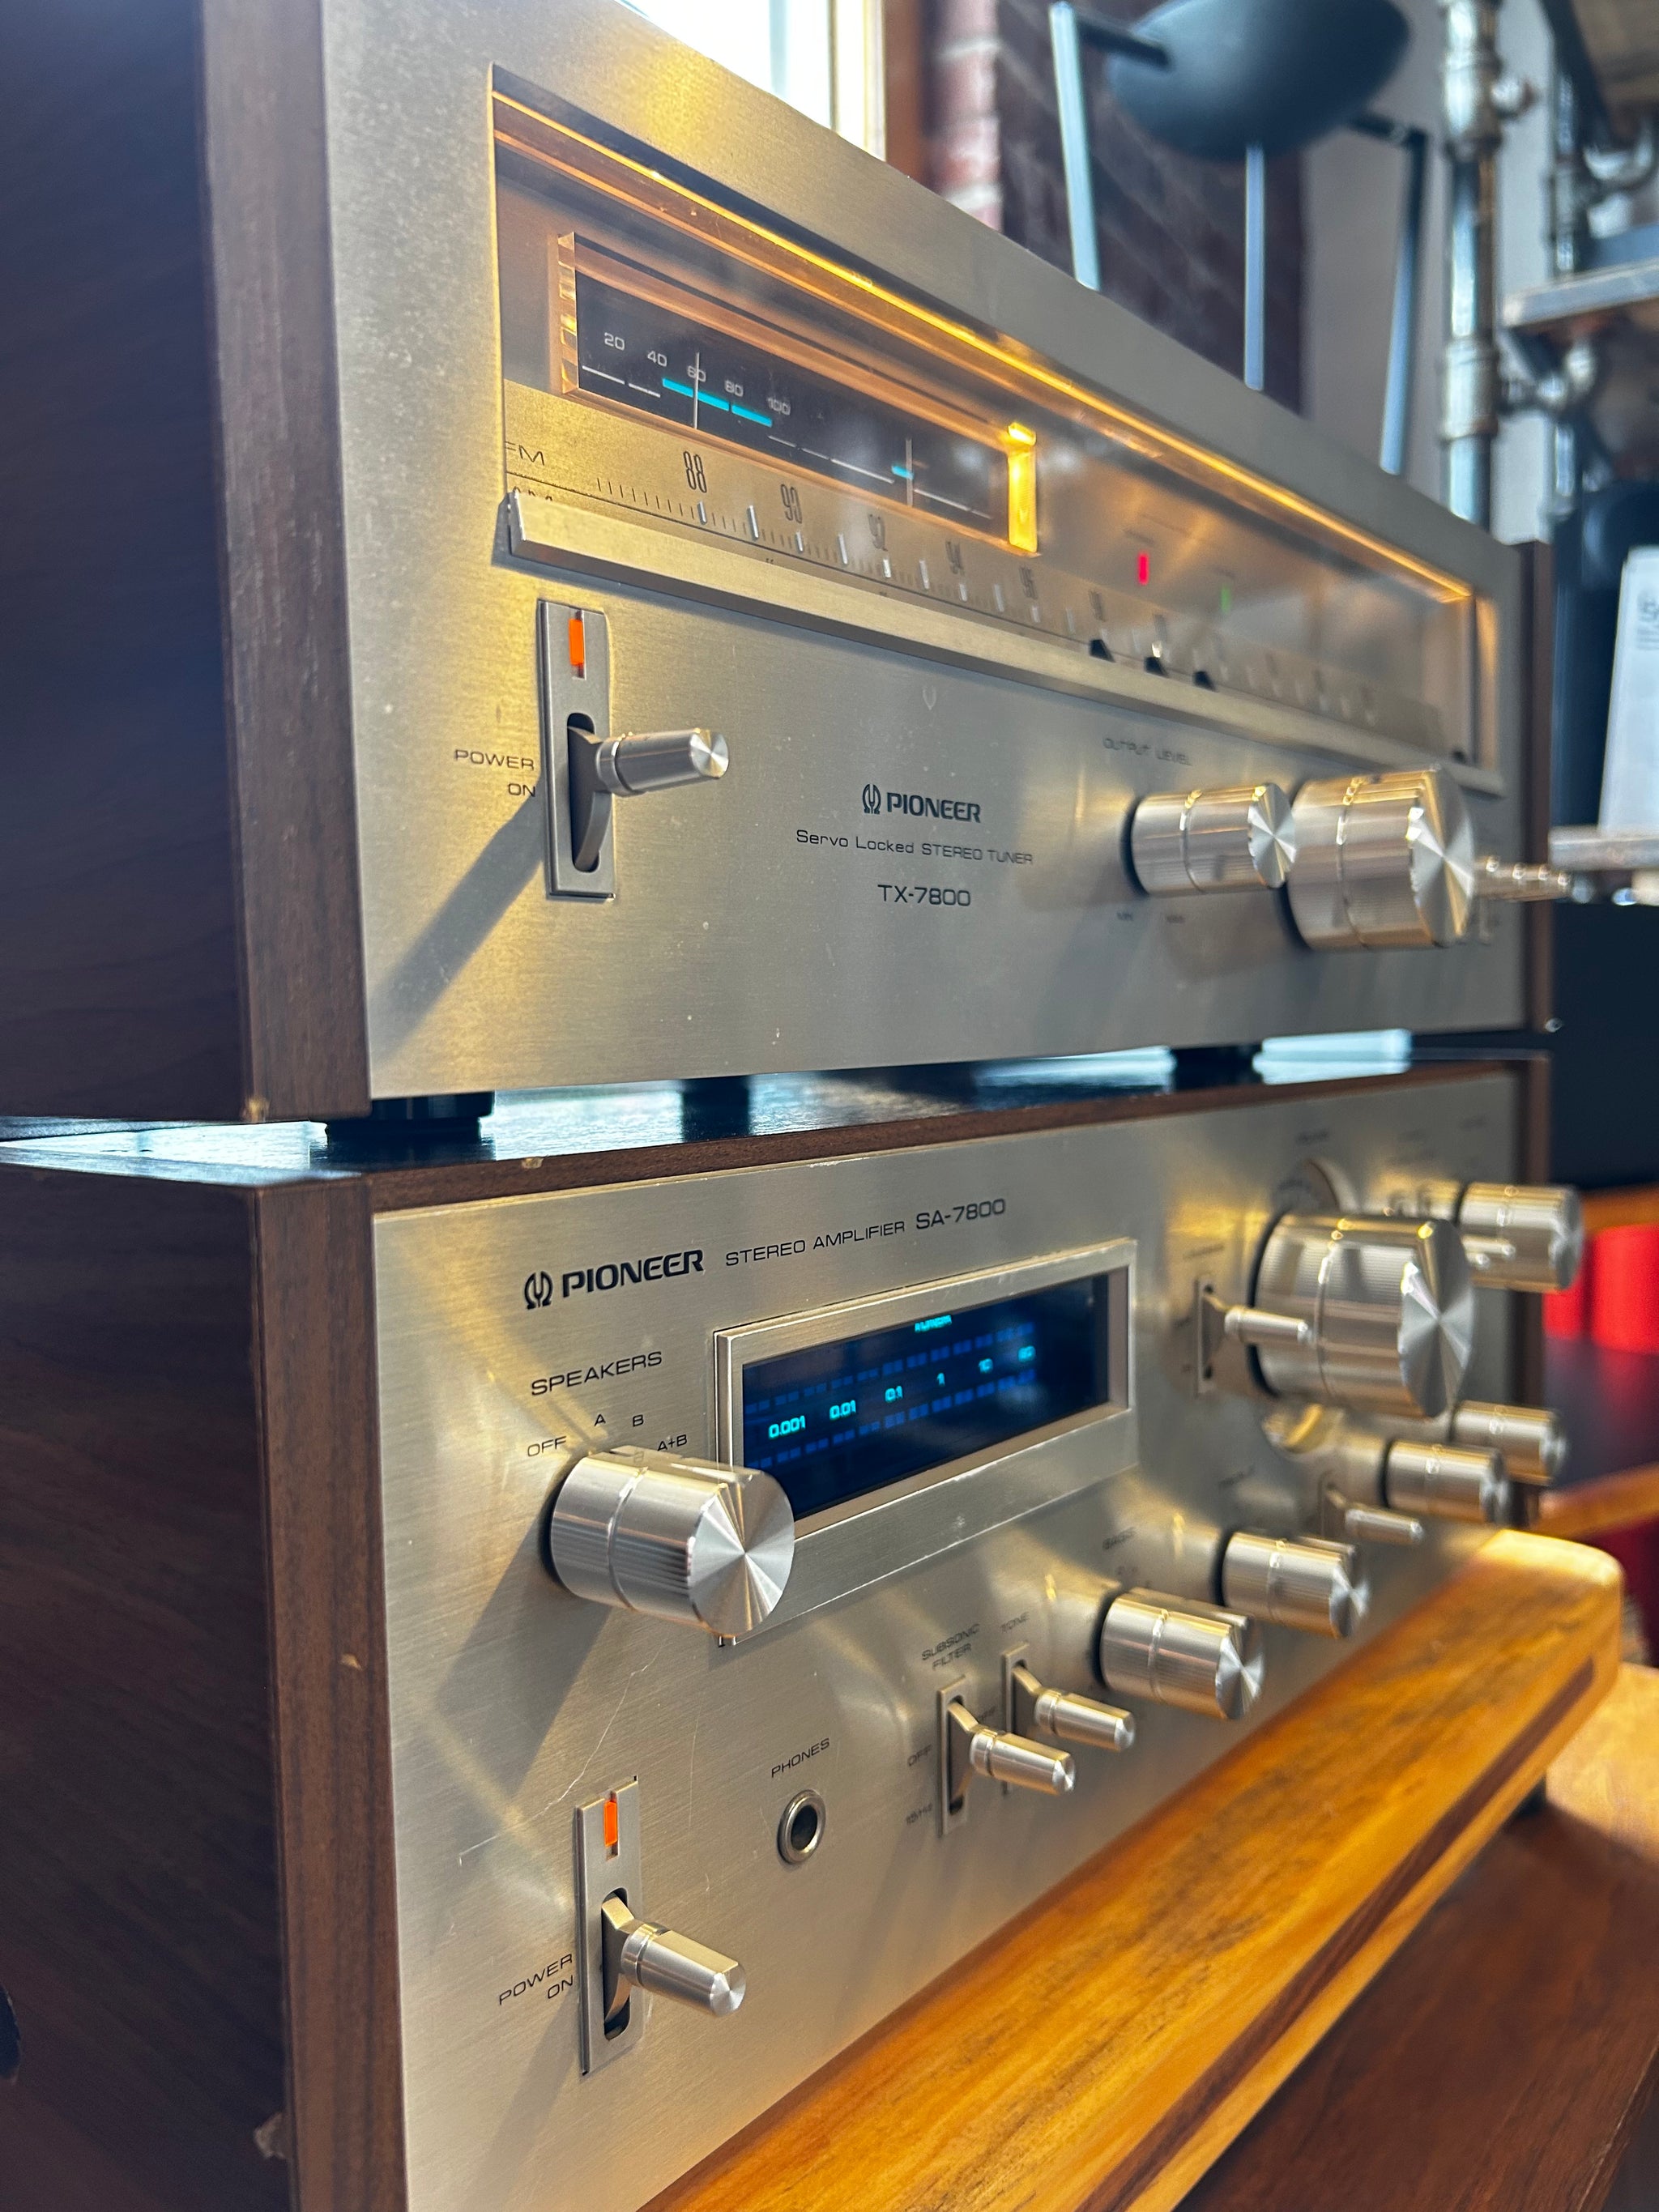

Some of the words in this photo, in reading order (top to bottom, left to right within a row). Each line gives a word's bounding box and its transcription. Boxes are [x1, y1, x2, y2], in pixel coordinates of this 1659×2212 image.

[603, 332, 625, 351] 20
[647, 350, 667, 368] 40
[687, 364, 707, 383] 60
[725, 379, 744, 398] 80
[767, 397, 791, 416] 100
[683, 450, 707, 493] 88
[780, 484, 803, 524] 90
[454, 748, 535, 771] POWER
[507, 782, 536, 797] ON
[886, 792, 981, 823] PIONEER
[795, 829, 849, 848] Servo
[855, 836, 915, 855] Locked
[921, 843, 983, 861] STEREO
[987, 849, 1034, 866] TUNER
[877, 884, 972, 906] TX-7800
[725, 1239, 806, 1267] STEREO
[812, 1221, 906, 1250] AMPLIFIER
[915, 1198, 1006, 1230] SA-7800
[561, 1248, 704, 1298] PIONEER
[531, 1350, 663, 1396] SPEAKERS
[594, 1413, 606, 1427] A
[632, 1414, 645, 1427] B
[769, 1415, 806, 1438] 0.001
[830, 1400, 856, 1420] 0.01
[527, 1435, 567, 1457] OFF
[657, 1434, 689, 1452] A+B
[921, 1622, 980, 1660] SUBSONIC
[932, 1642, 972, 1671] FILTER
[771, 1737, 830, 1778] PHONES
[499, 1953, 572, 2005] POWER
[548, 1975, 574, 2000] ON
